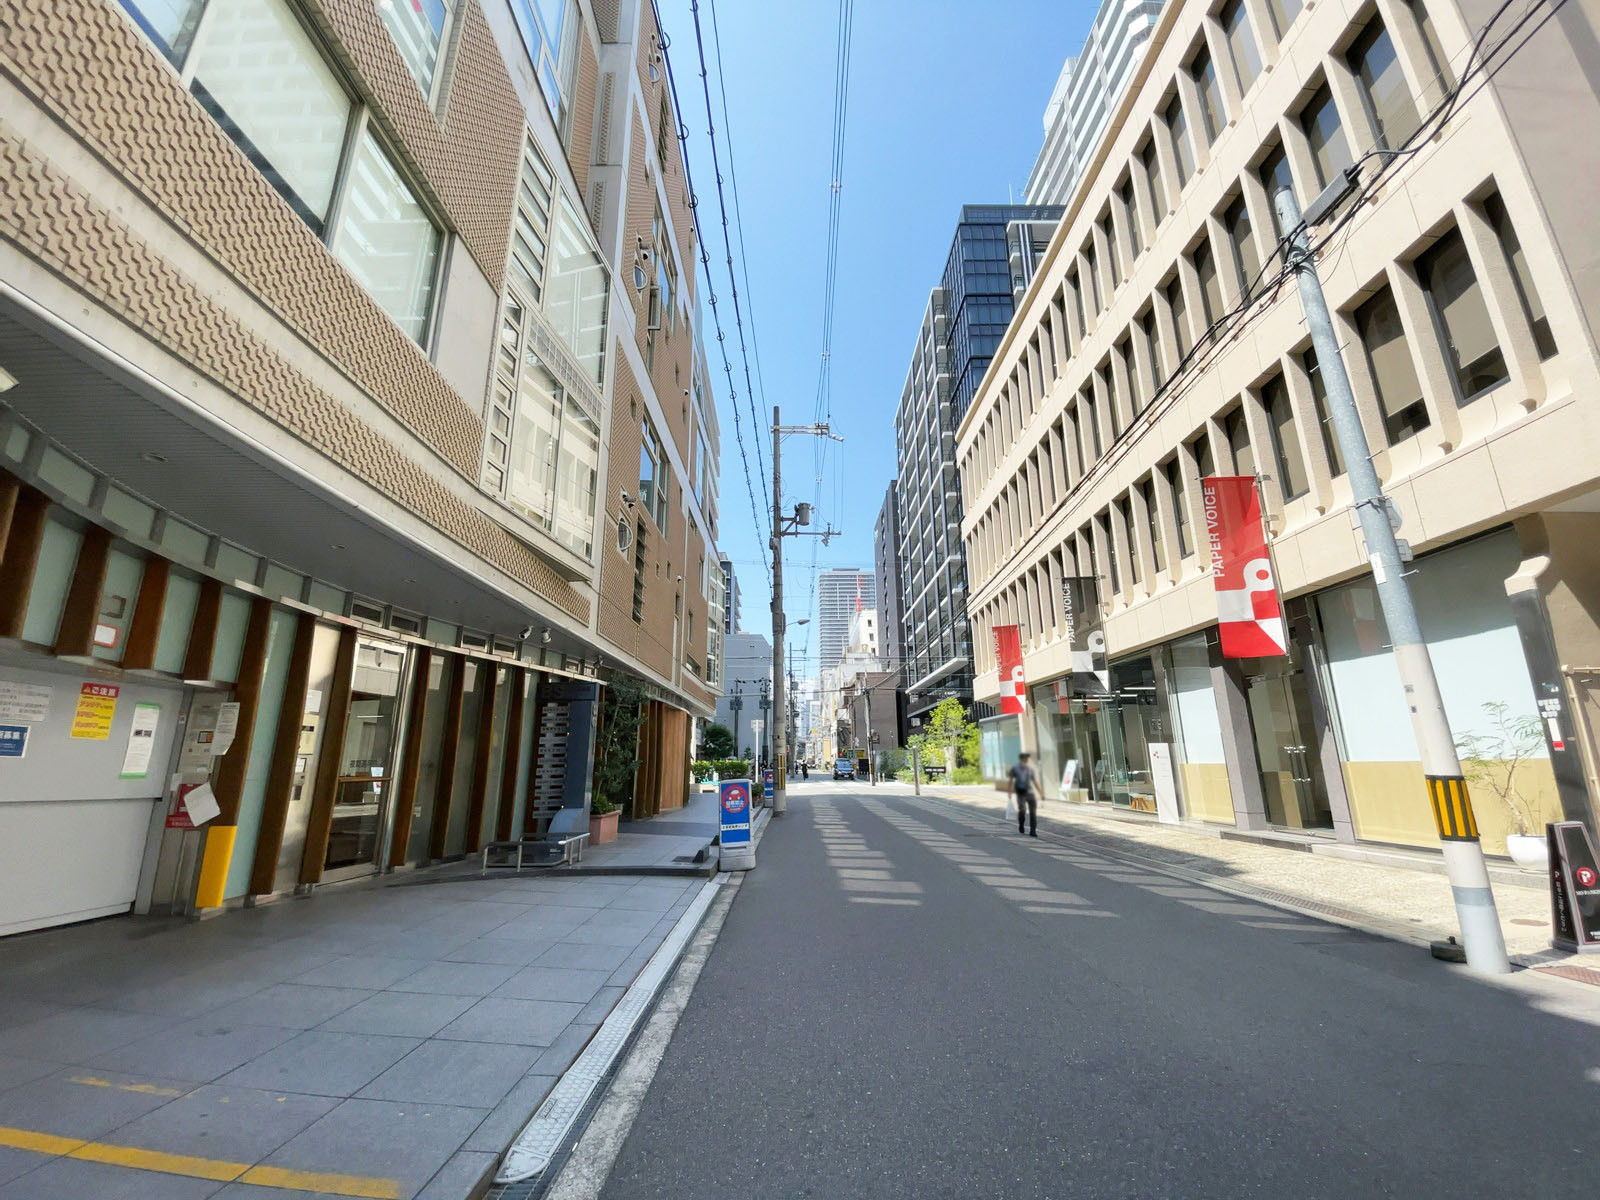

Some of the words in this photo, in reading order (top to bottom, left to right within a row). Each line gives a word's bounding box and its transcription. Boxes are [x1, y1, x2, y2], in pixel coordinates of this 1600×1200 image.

[1204, 487, 1219, 530] VOICE
[1208, 533, 1225, 578] PAPER
[1063, 582, 1073, 613] VOICE
[1065, 613, 1076, 643] PAPER
[91, 686, 117, 697] ご注意
